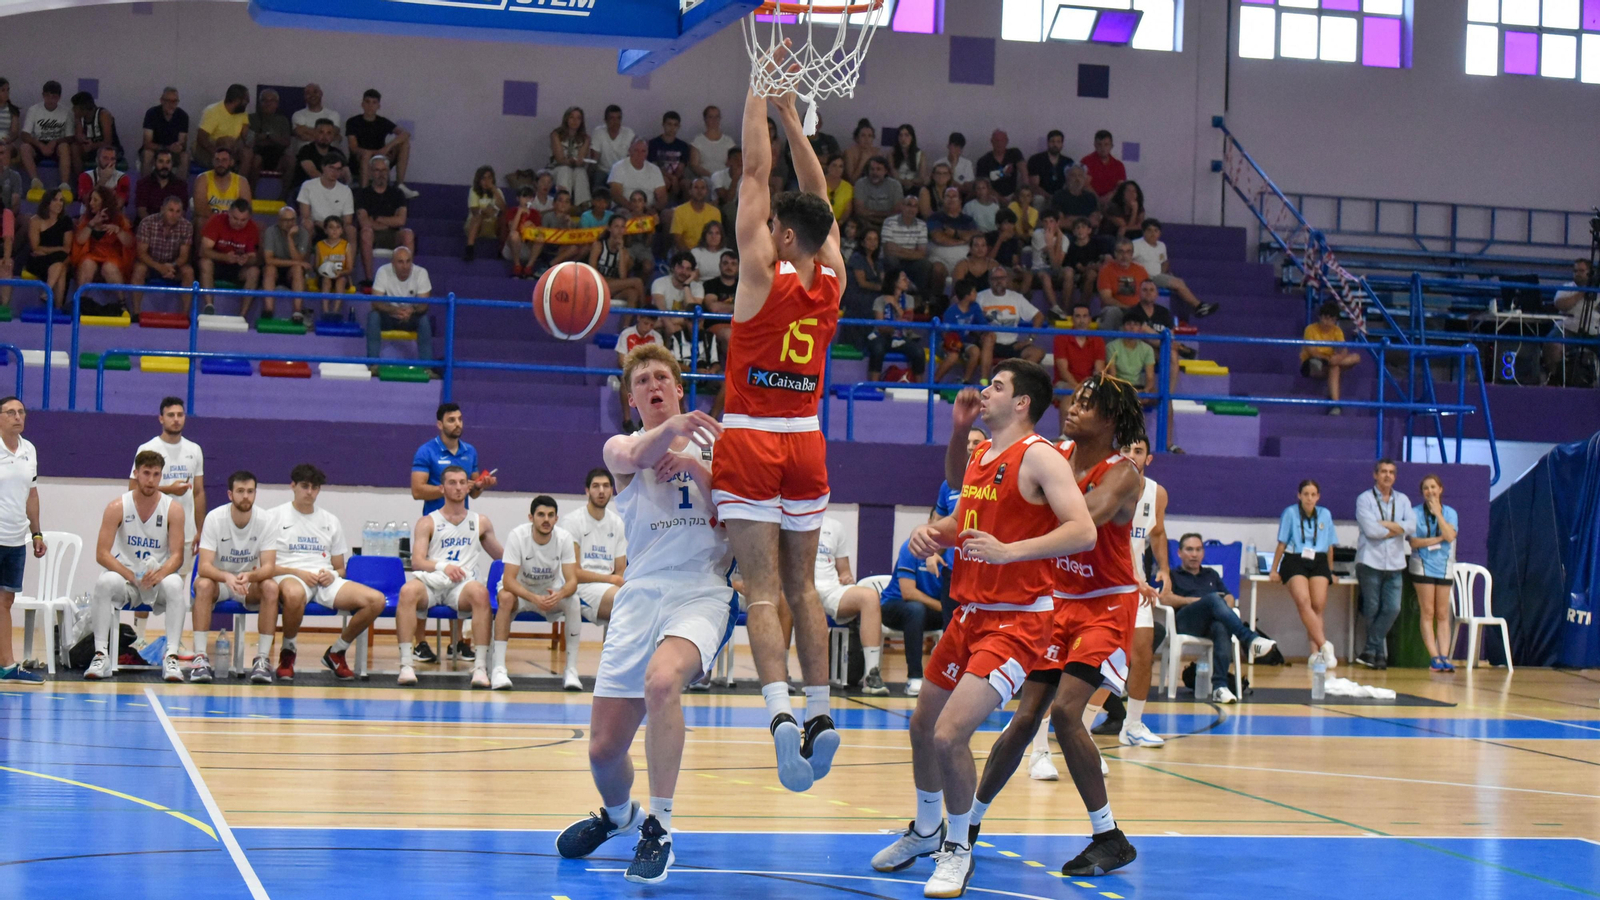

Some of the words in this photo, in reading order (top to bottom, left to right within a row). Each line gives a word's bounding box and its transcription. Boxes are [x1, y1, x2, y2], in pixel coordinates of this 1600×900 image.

[780, 318, 818, 364] 15
[768, 372, 817, 392] CaixaBan
[678, 485, 693, 509] 1
[689, 517, 706, 527] בנק
[127, 535, 161, 549] ISRAEL
[297, 536, 319, 544] ISRAEL
[446, 550, 460, 562] 11
